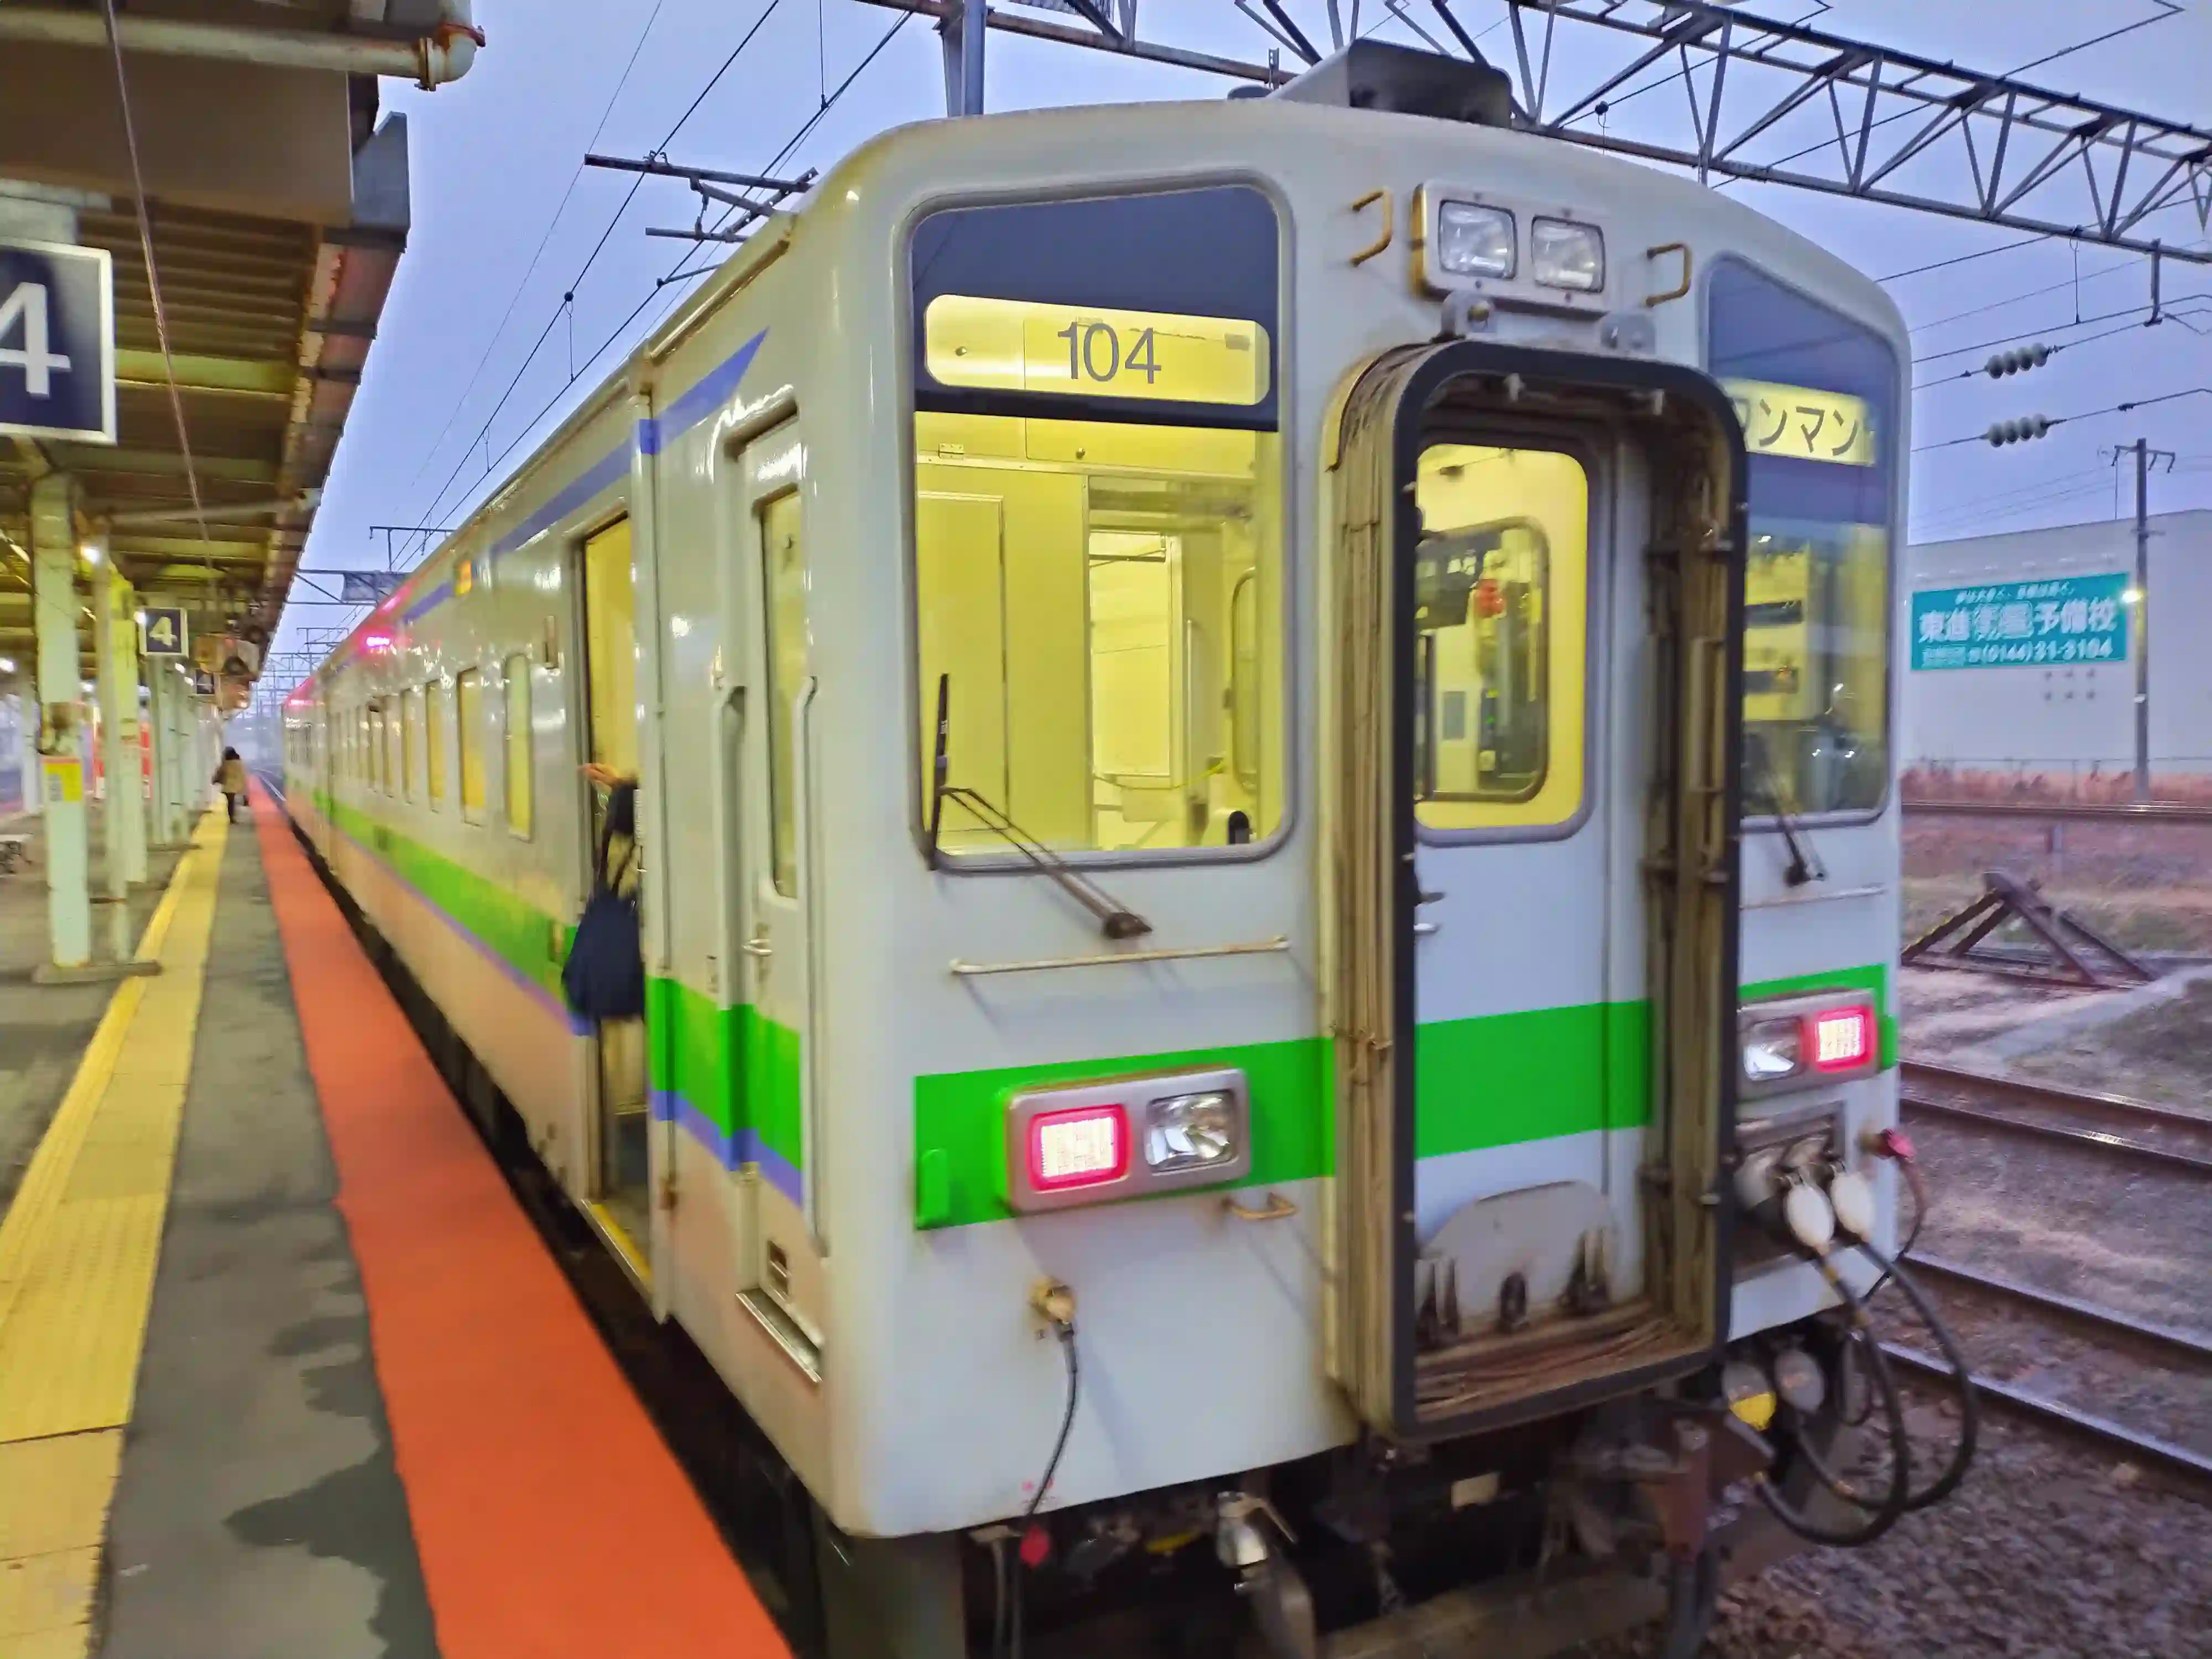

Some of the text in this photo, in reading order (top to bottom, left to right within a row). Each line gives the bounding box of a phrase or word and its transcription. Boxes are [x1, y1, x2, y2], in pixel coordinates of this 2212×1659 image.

[0, 281, 72, 398] 4
[1057, 321, 1162, 384] 104
[149, 616, 178, 648] 4
